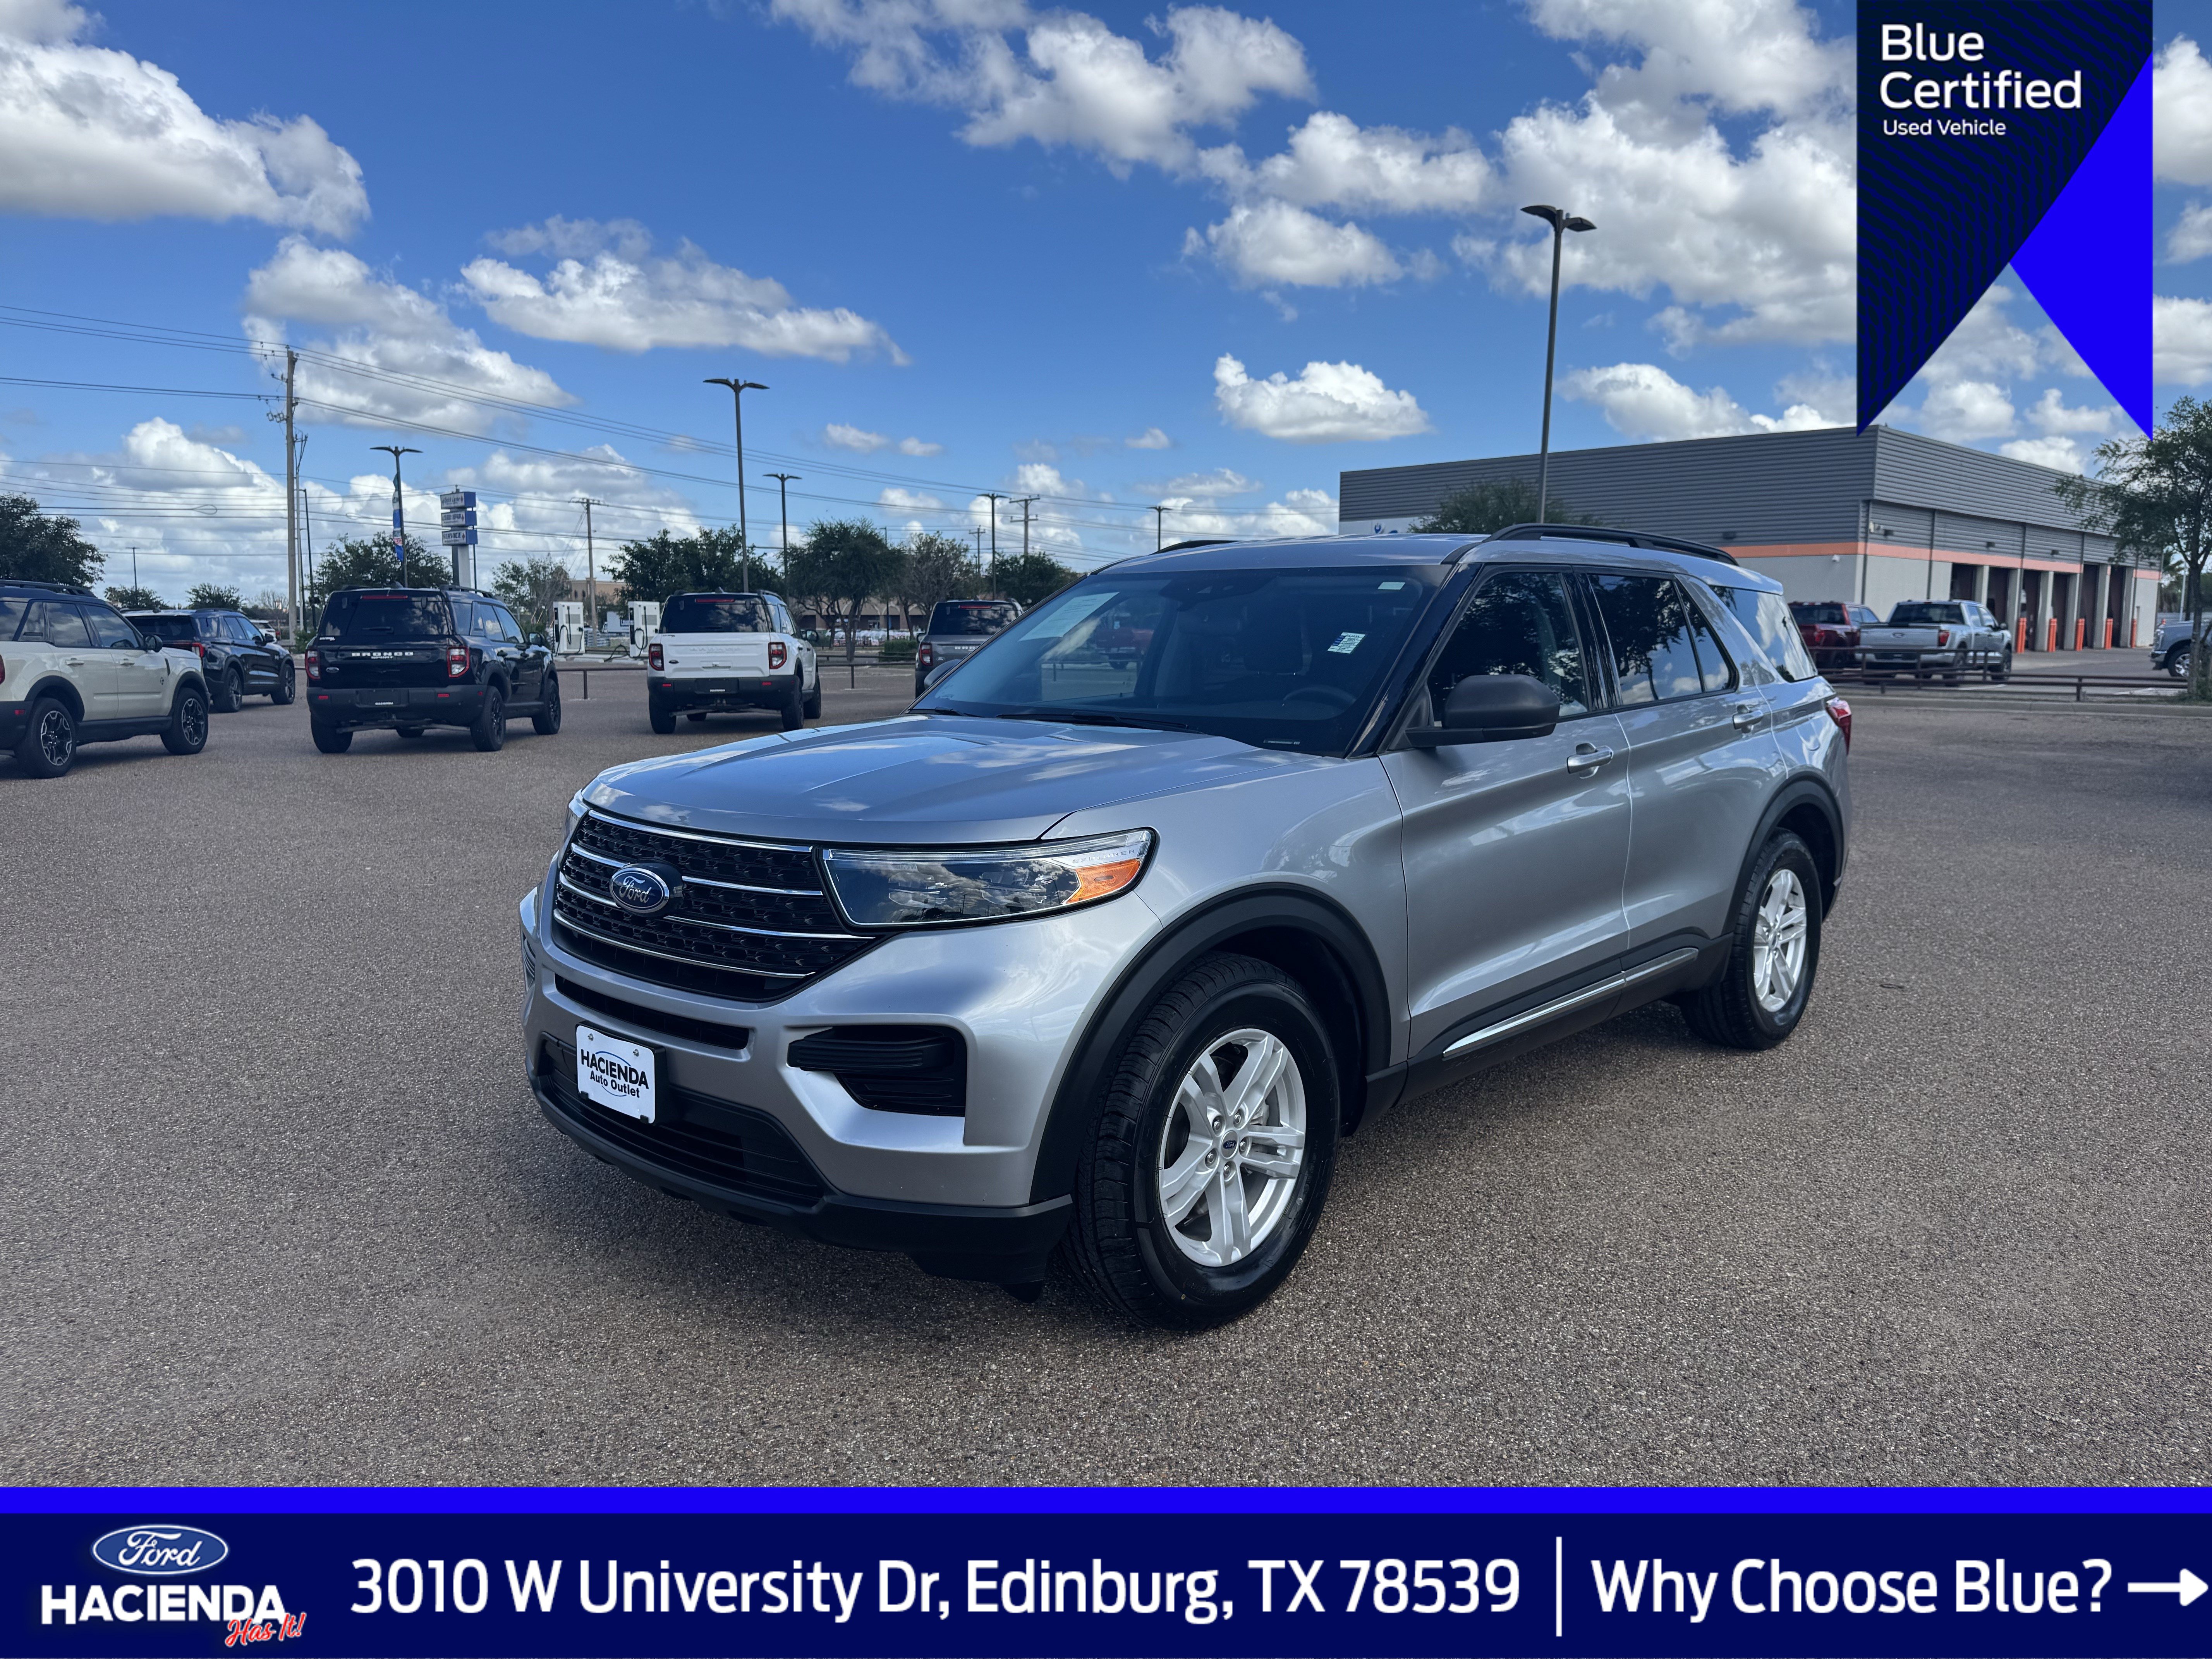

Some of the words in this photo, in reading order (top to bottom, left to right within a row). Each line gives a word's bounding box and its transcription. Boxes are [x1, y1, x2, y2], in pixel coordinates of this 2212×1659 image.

[1072, 850, 1135, 864] EXPLORER
[619, 876, 652, 903] Ford
[581, 1049, 649, 1089] HACIENDA
[590, 1070, 608, 1087] Auto
[610, 1079, 640, 1098] Outlet
